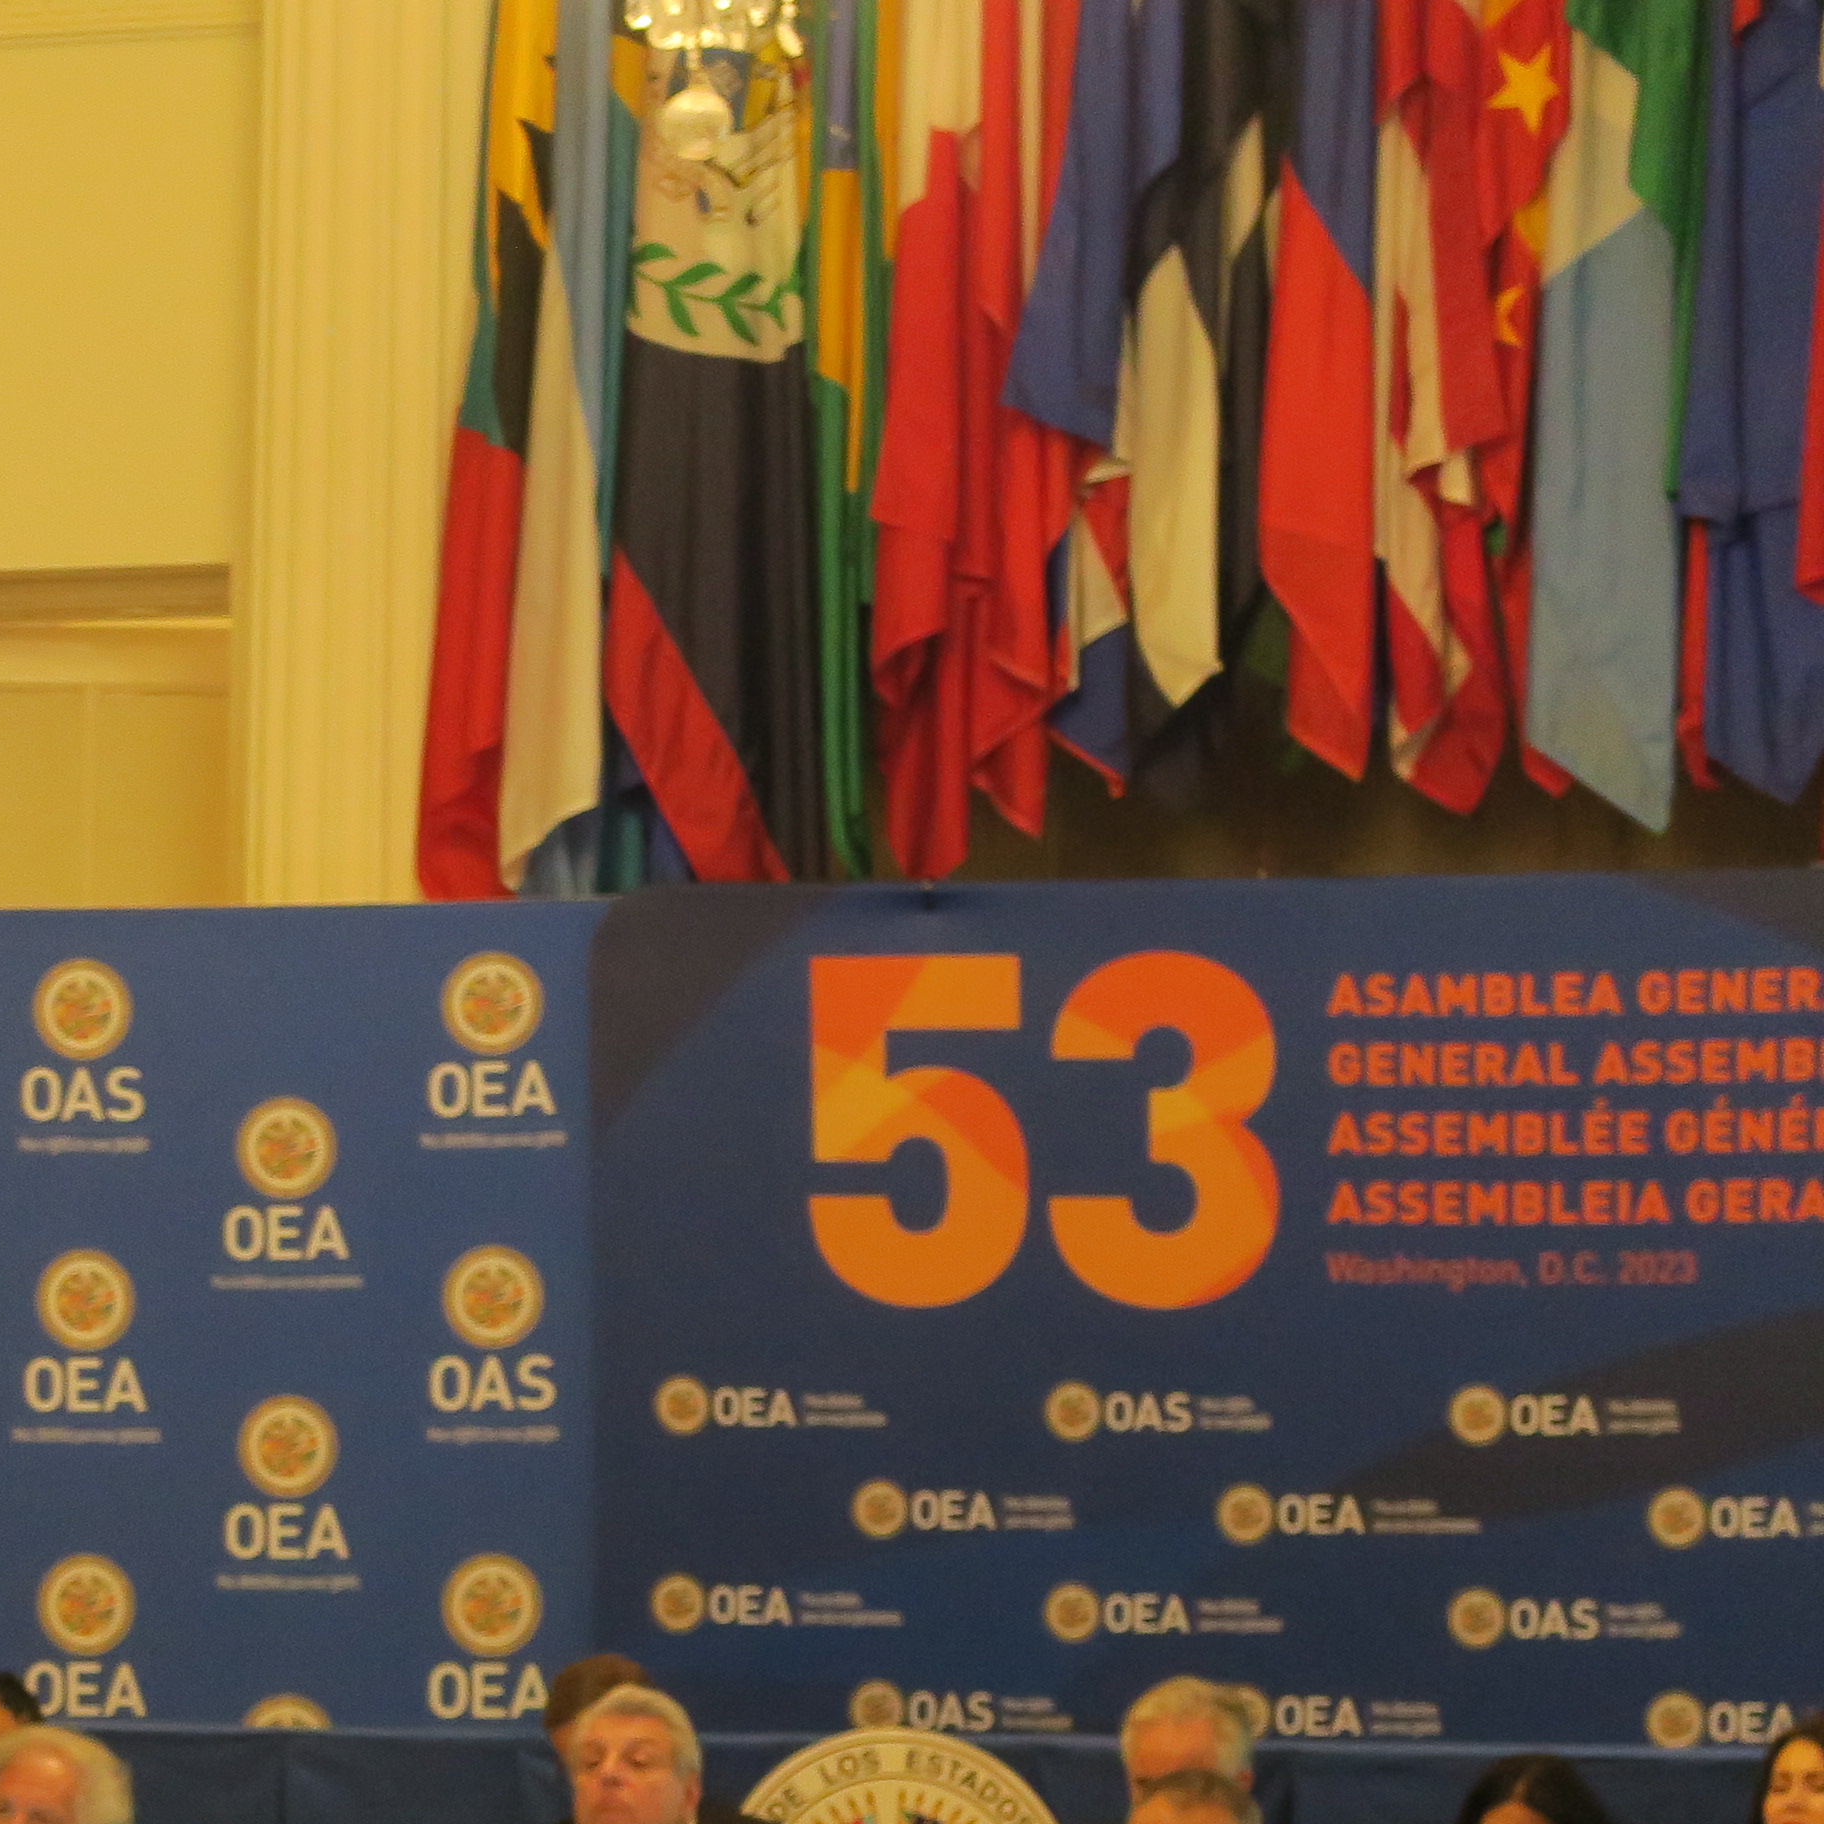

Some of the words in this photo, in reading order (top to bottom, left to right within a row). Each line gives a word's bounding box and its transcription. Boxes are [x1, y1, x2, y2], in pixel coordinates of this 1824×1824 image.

[1327, 972, 1623, 1017] ASAMBLEA
[1638, 968, 1824, 1014] GENER
[1327, 1043, 1579, 1086] GENERAL
[1593, 1038, 1824, 1084] ASSEMB
[20, 1067, 145, 1122] OAS
[427, 1061, 556, 1118] OEA
[809, 951, 1280, 1310] 53
[1327, 1098, 1649, 1155] ASSEMBLÉE
[1327, 1181, 1671, 1225] ASSEMBLEIA
[223, 1205, 349, 1261] OEA
[23, 1358, 148, 1413] OEA
[429, 1354, 558, 1412] OAS
[712, 1387, 798, 1428] OEA
[1103, 1392, 1194, 1433] OAS
[1510, 1395, 1599, 1436] OEA
[224, 1503, 350, 1560] OEA
[910, 1490, 997, 1531] OEA
[1277, 1494, 1366, 1536] OEA
[1710, 1497, 1801, 1539] OEA
[708, 1586, 792, 1626] OEA
[1104, 1593, 1192, 1635] OEA
[1508, 1598, 1600, 1640] OAS
[24, 1661, 146, 1718] OEA
[427, 1662, 549, 1720] OEA
[908, 1691, 996, 1733] OAS
[1274, 1695, 1363, 1737] OEA
[1707, 1701, 1793, 1745] OEA
[819, 1750, 880, 1787] LOS
